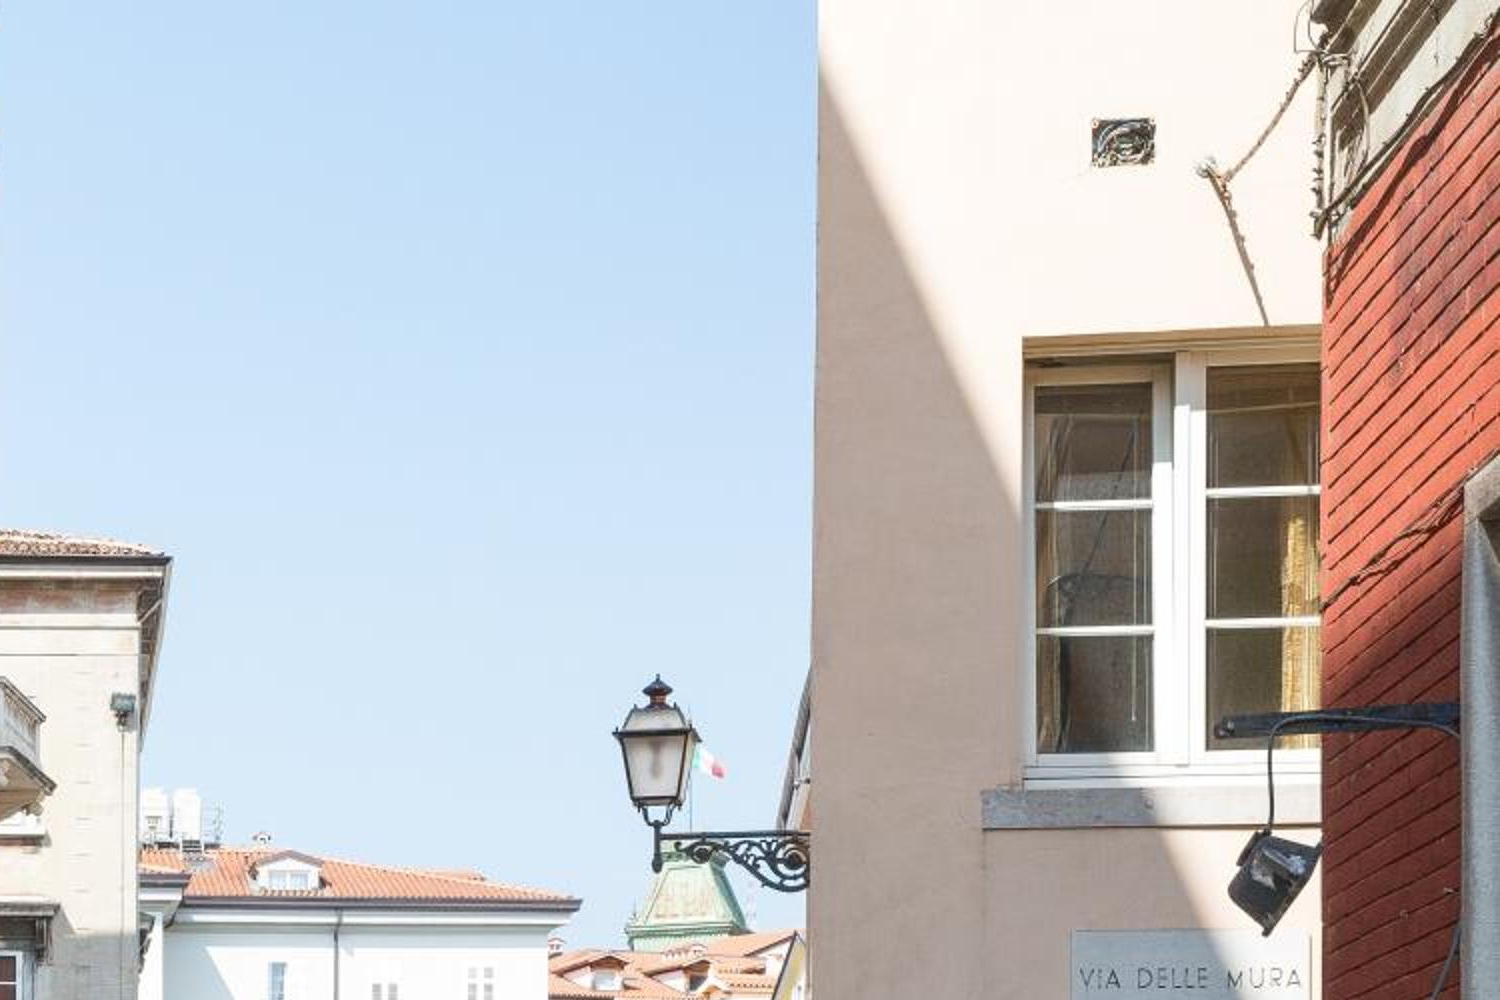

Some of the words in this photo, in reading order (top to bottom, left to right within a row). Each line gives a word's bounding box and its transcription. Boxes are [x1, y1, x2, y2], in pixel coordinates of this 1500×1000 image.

[1078, 966, 1122, 991] VIA
[1136, 966, 1208, 990] DELLE
[1226, 966, 1302, 990] MURA
